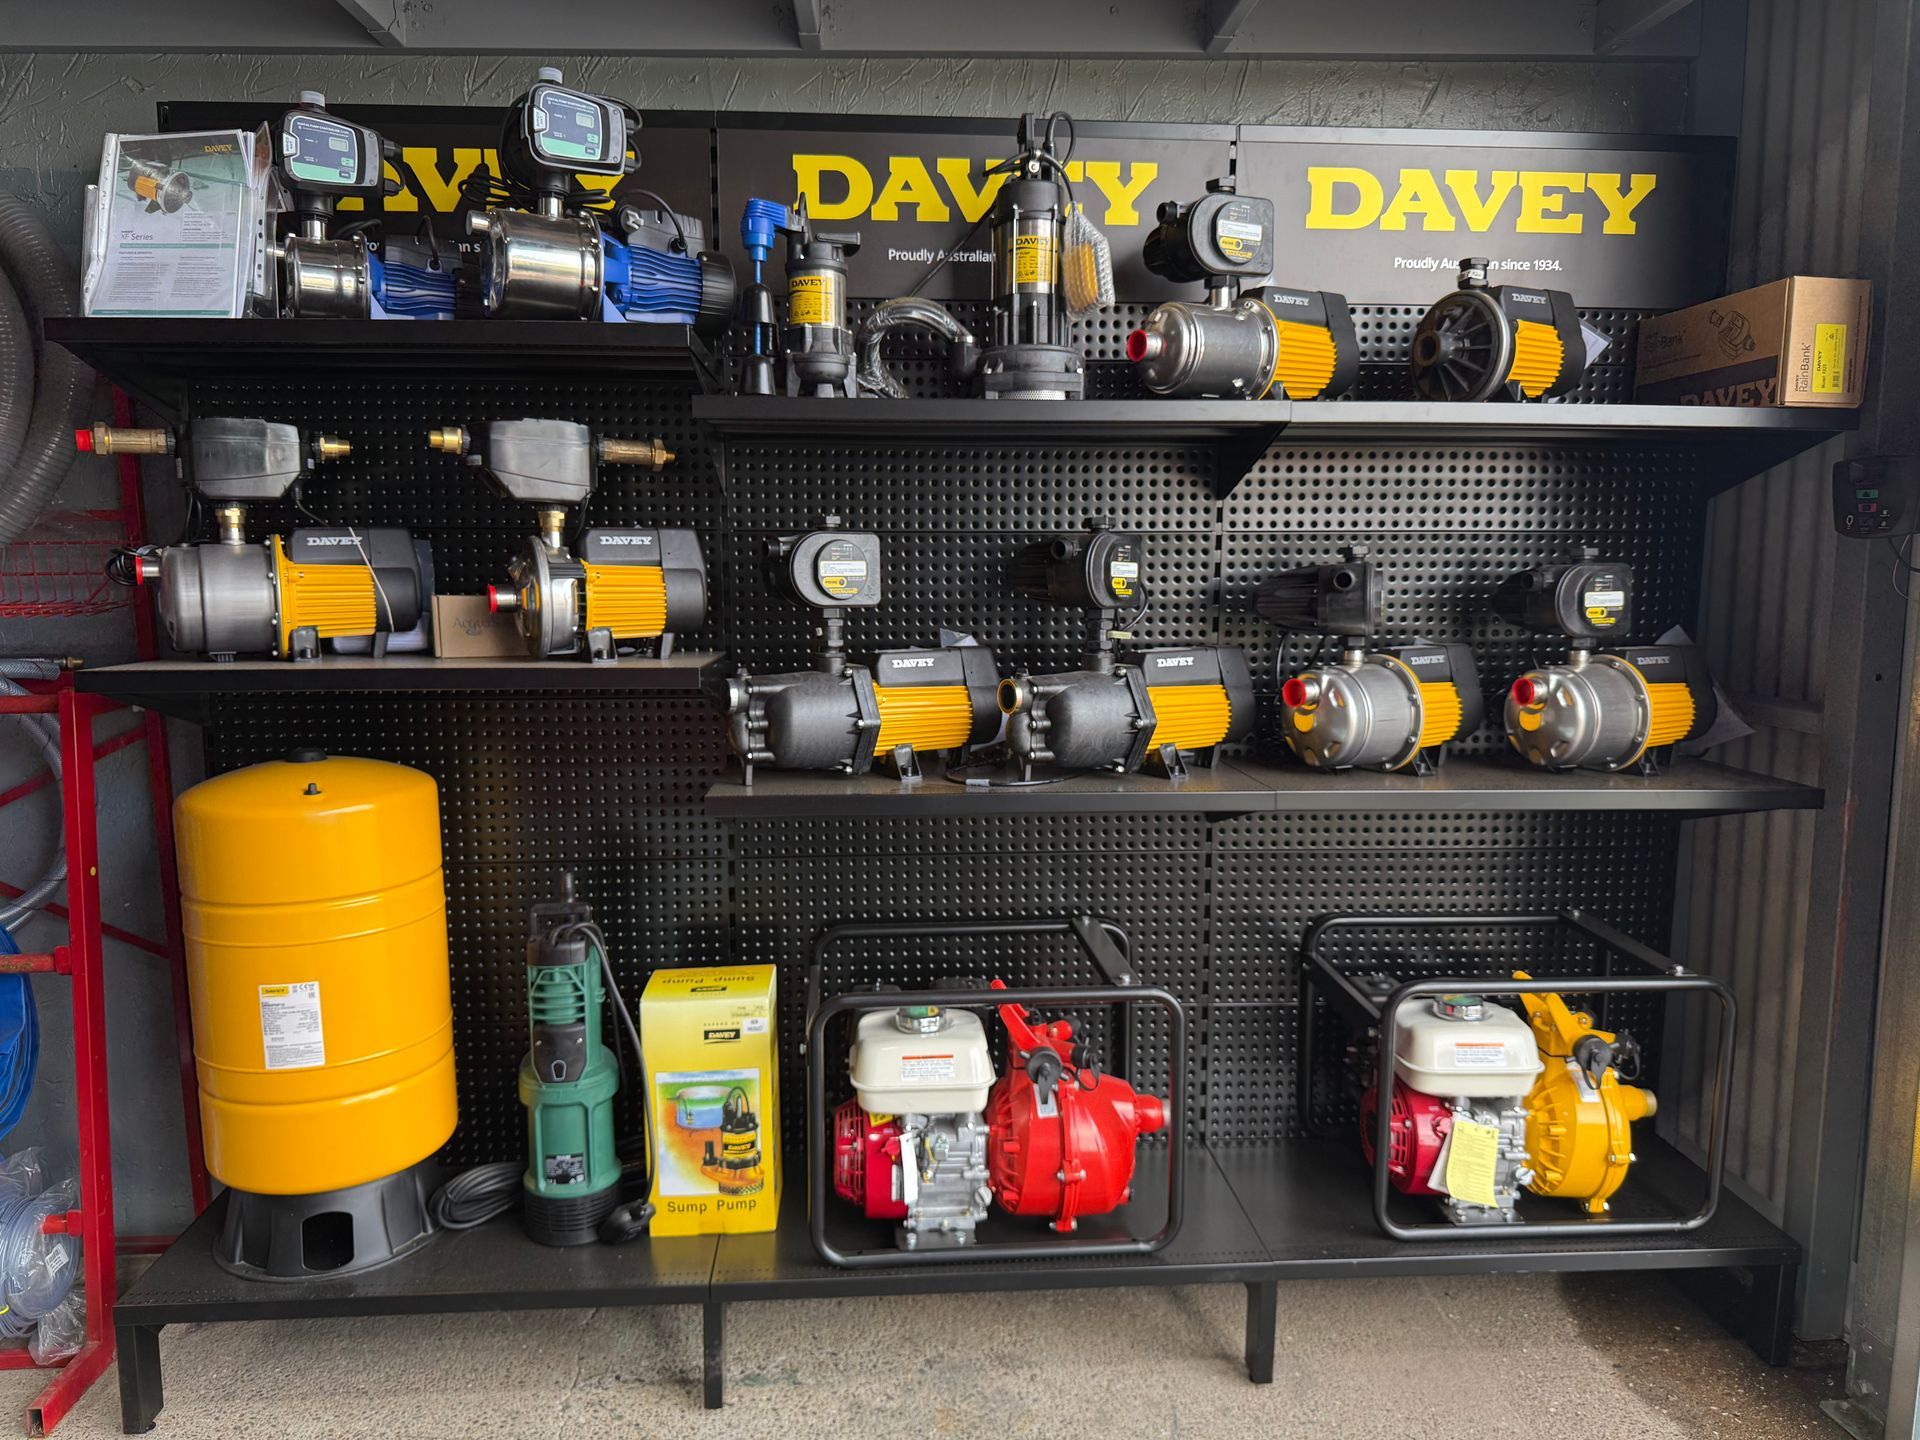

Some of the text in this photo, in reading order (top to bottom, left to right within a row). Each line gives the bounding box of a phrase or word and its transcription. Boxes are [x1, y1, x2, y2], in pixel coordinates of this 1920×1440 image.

[204, 144, 233, 153] DAVEY
[1305, 166, 1657, 236] DAVEY
[131, 232, 154, 240] Series
[888, 249, 934, 264] Proudly
[1394, 256, 1439, 271] Proudly
[1501, 258, 1531, 270] since
[1533, 259, 1563, 271] 1934.
[791, 279, 826, 288] DAVEY
[1273, 293, 1310, 306] DAVEY
[1511, 292, 1547, 305] DAVEY
[1798, 343, 1811, 393] RainBank
[307, 536, 363, 547] DAVEY
[599, 536, 652, 545] DAVEY
[892, 657, 935, 669] DAVEY
[1156, 656, 1194, 668] DAVEY
[1411, 654, 1445, 665] DAVEY
[1637, 656, 1670, 665] DAVEY
[708, 1031, 736, 1039] DAVEY
[667, 1198, 757, 1214] Sump Pump
